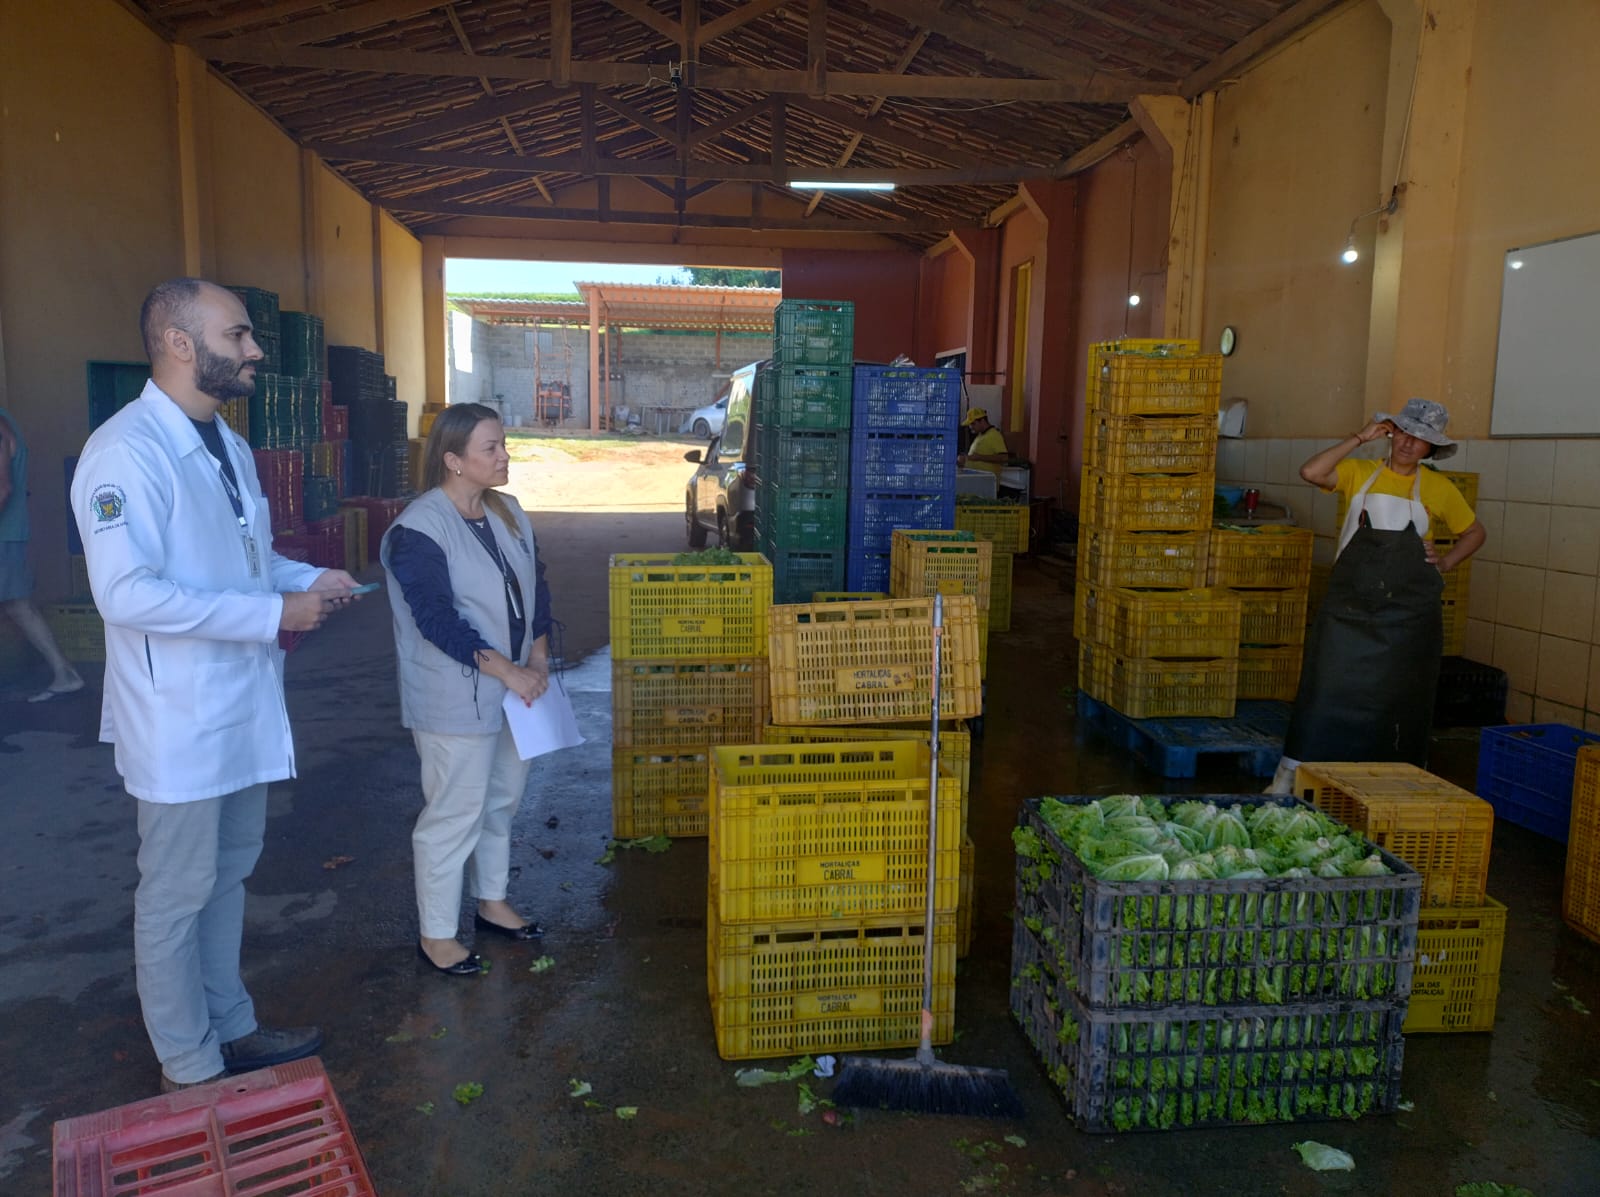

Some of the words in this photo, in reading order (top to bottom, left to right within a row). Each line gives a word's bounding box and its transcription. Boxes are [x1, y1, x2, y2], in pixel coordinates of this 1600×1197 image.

[855, 681, 889, 690] CABRAL
[823, 869, 857, 881] CABRAL
[820, 1002, 852, 1013] CABRAL
